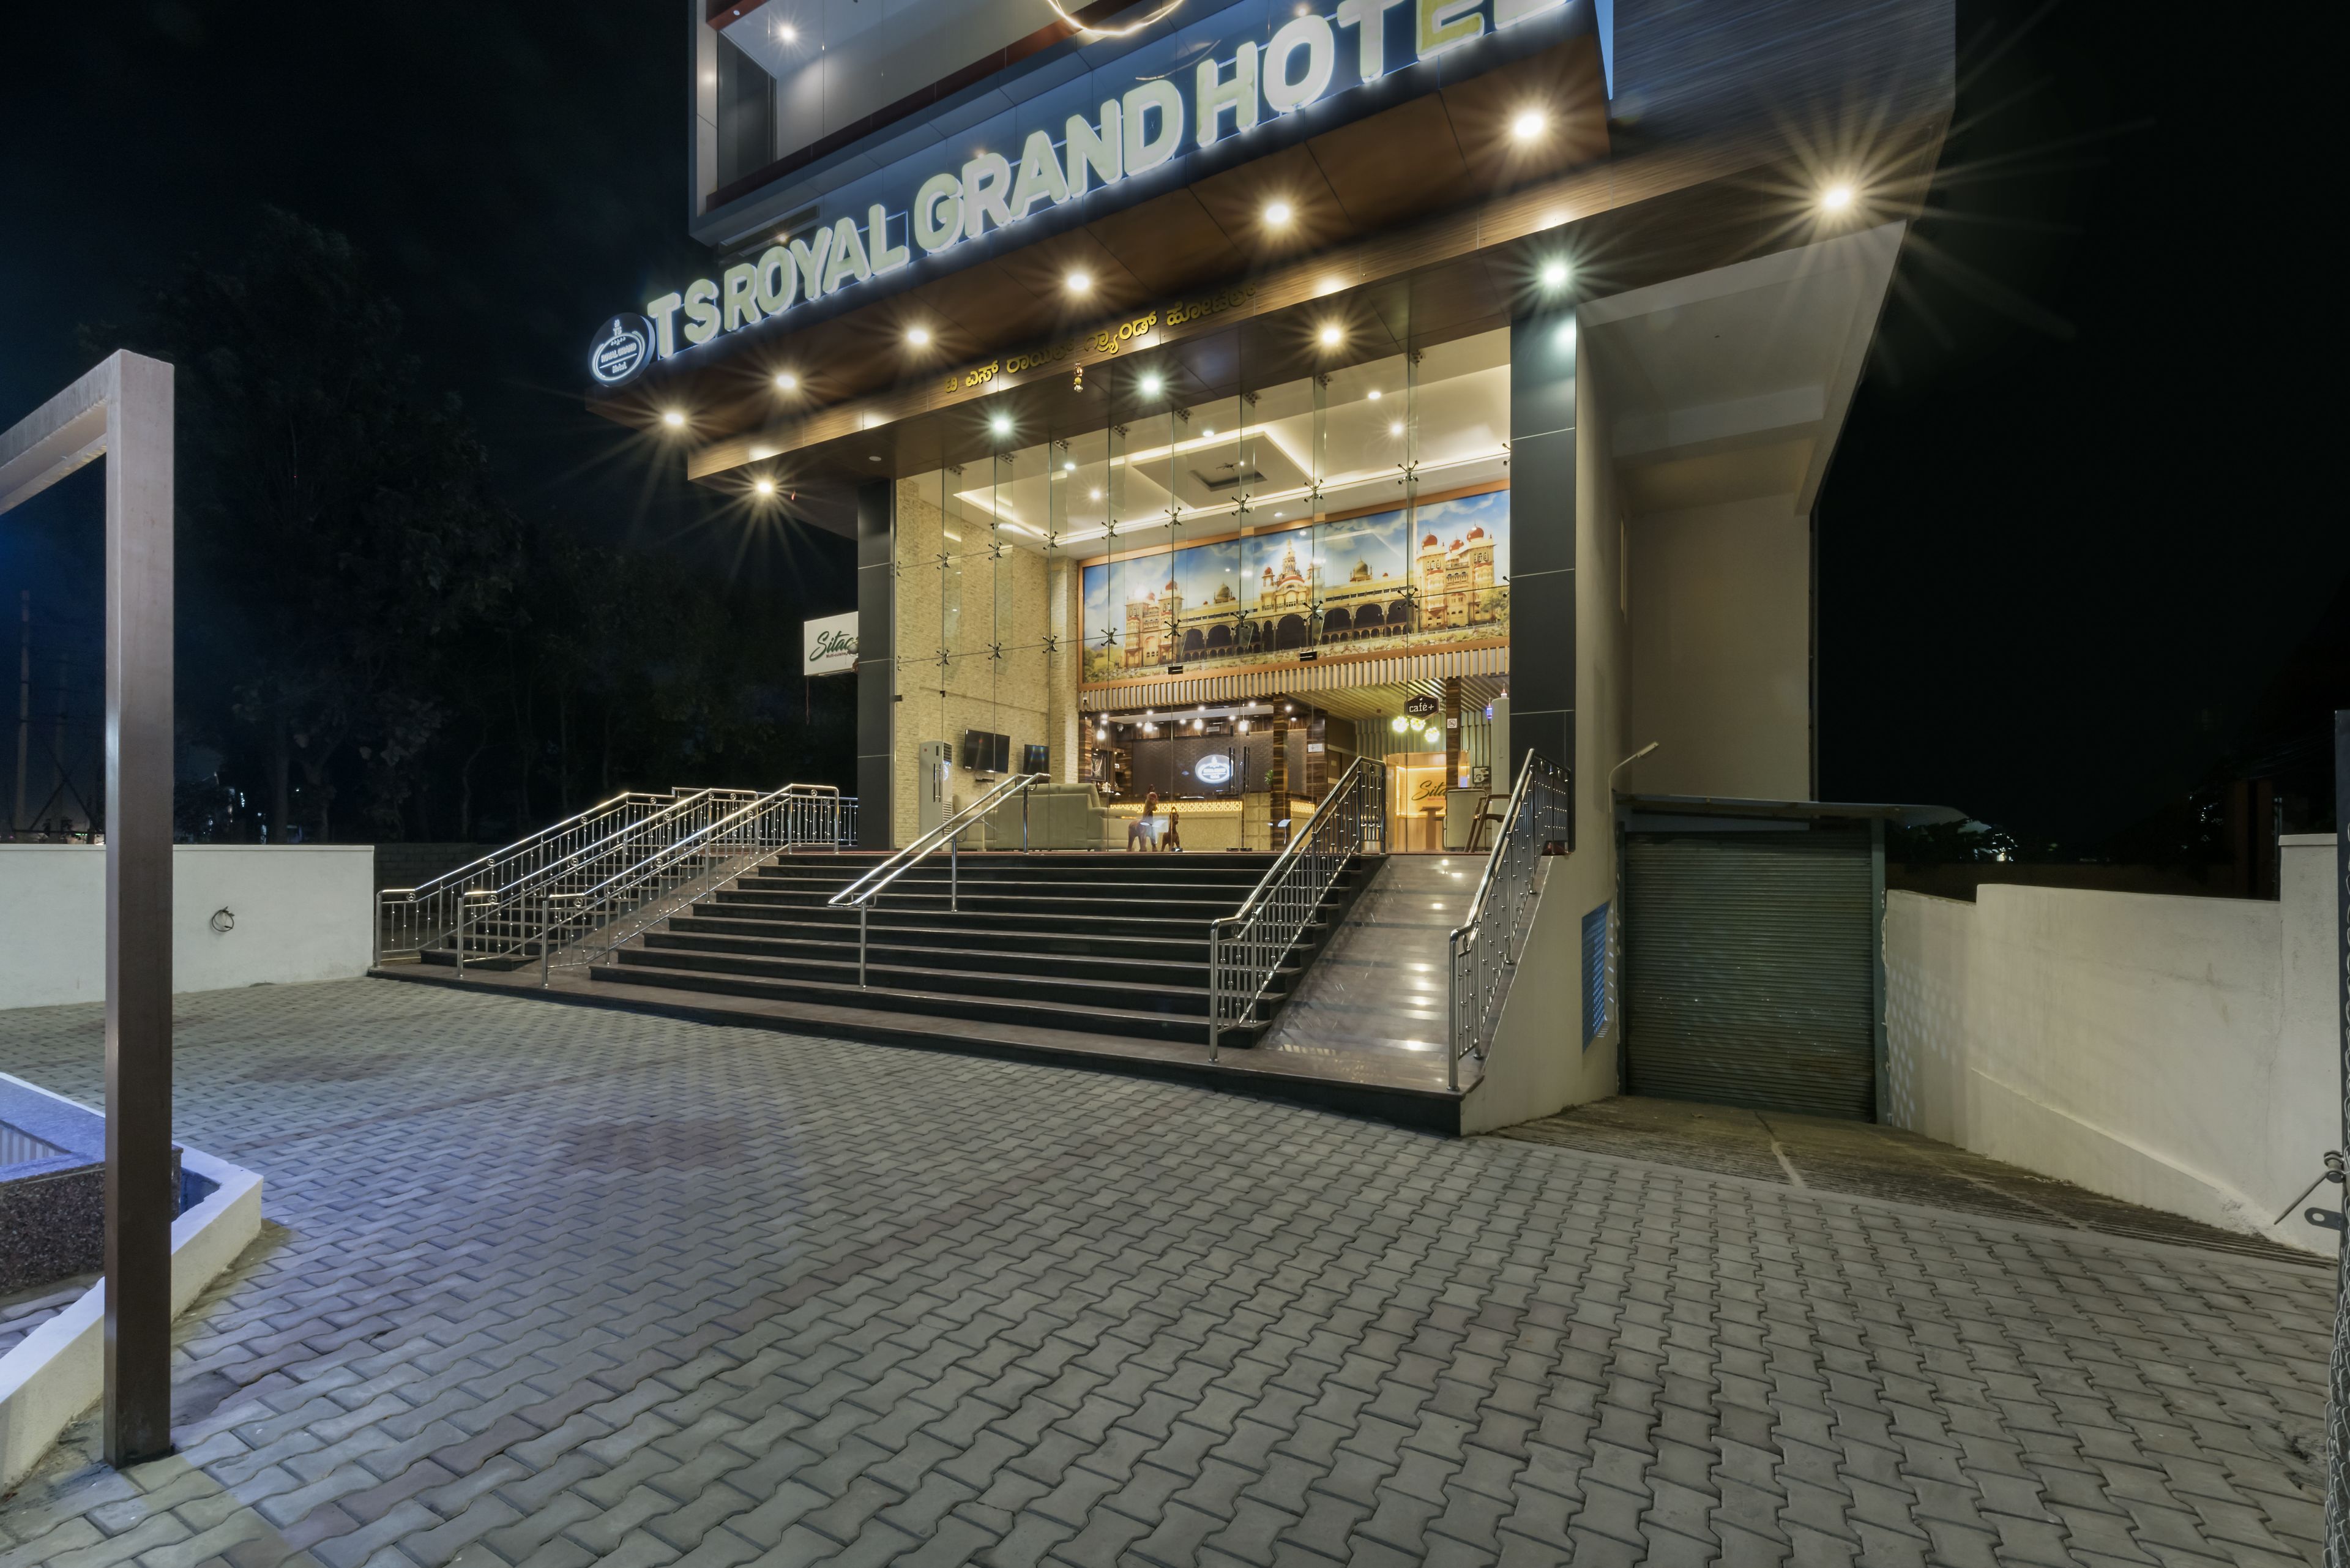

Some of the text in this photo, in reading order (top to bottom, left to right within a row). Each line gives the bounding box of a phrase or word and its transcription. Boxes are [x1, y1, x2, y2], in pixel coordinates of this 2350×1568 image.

[723, 204, 909, 332] ROYAL
[914, 79, 1184, 253] GRAND
[966, 359, 999, 387] ಎಸ್
